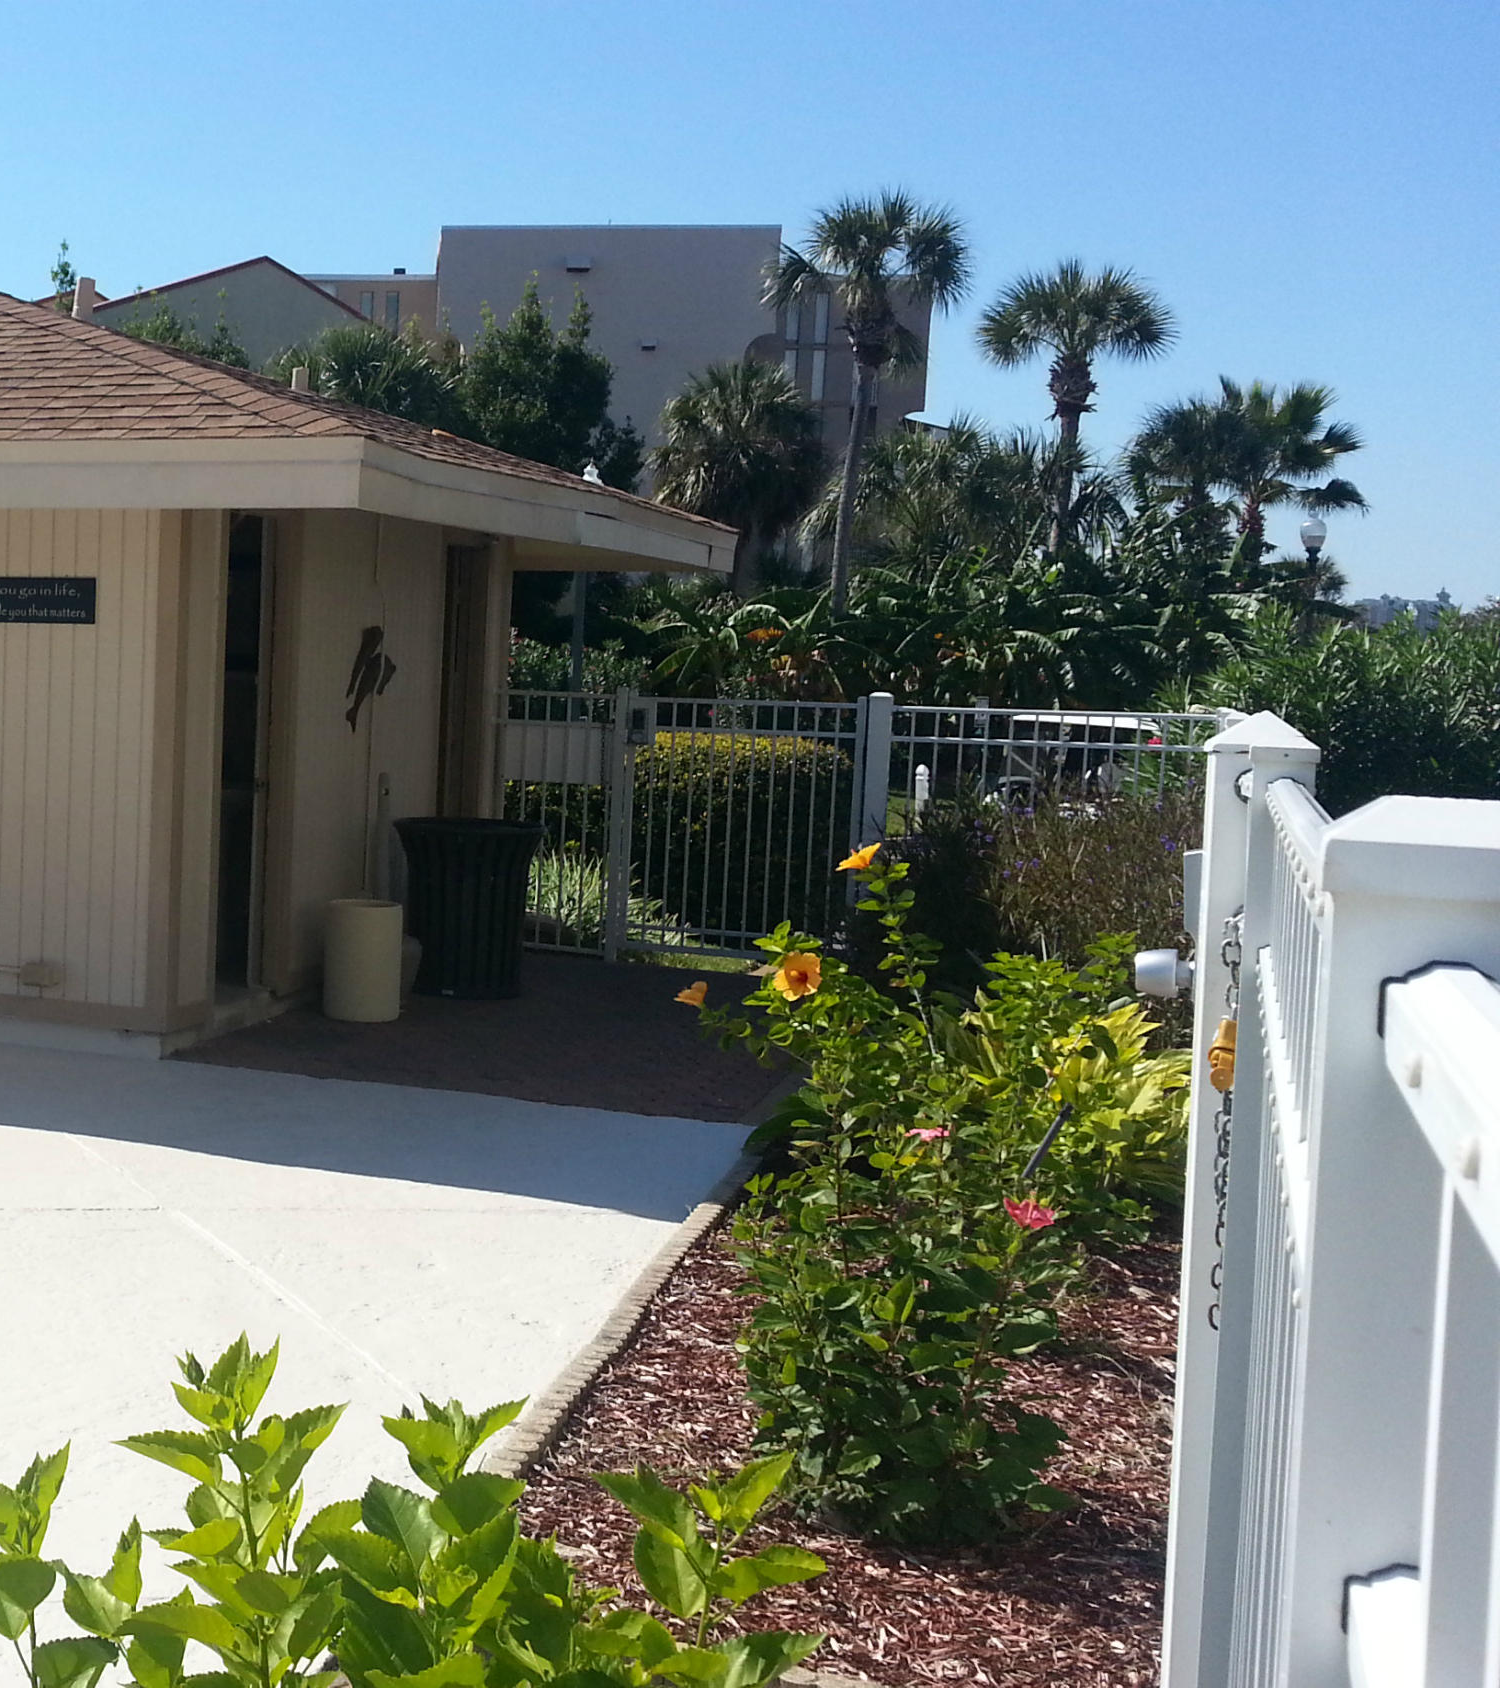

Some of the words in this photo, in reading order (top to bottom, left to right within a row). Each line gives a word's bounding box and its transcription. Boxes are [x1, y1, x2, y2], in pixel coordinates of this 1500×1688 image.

[18, 587, 36, 600] go
[39, 586, 52, 596] in
[54, 583, 81, 598] life,
[8, 608, 27, 621] you
[28, 603, 48, 617] that
